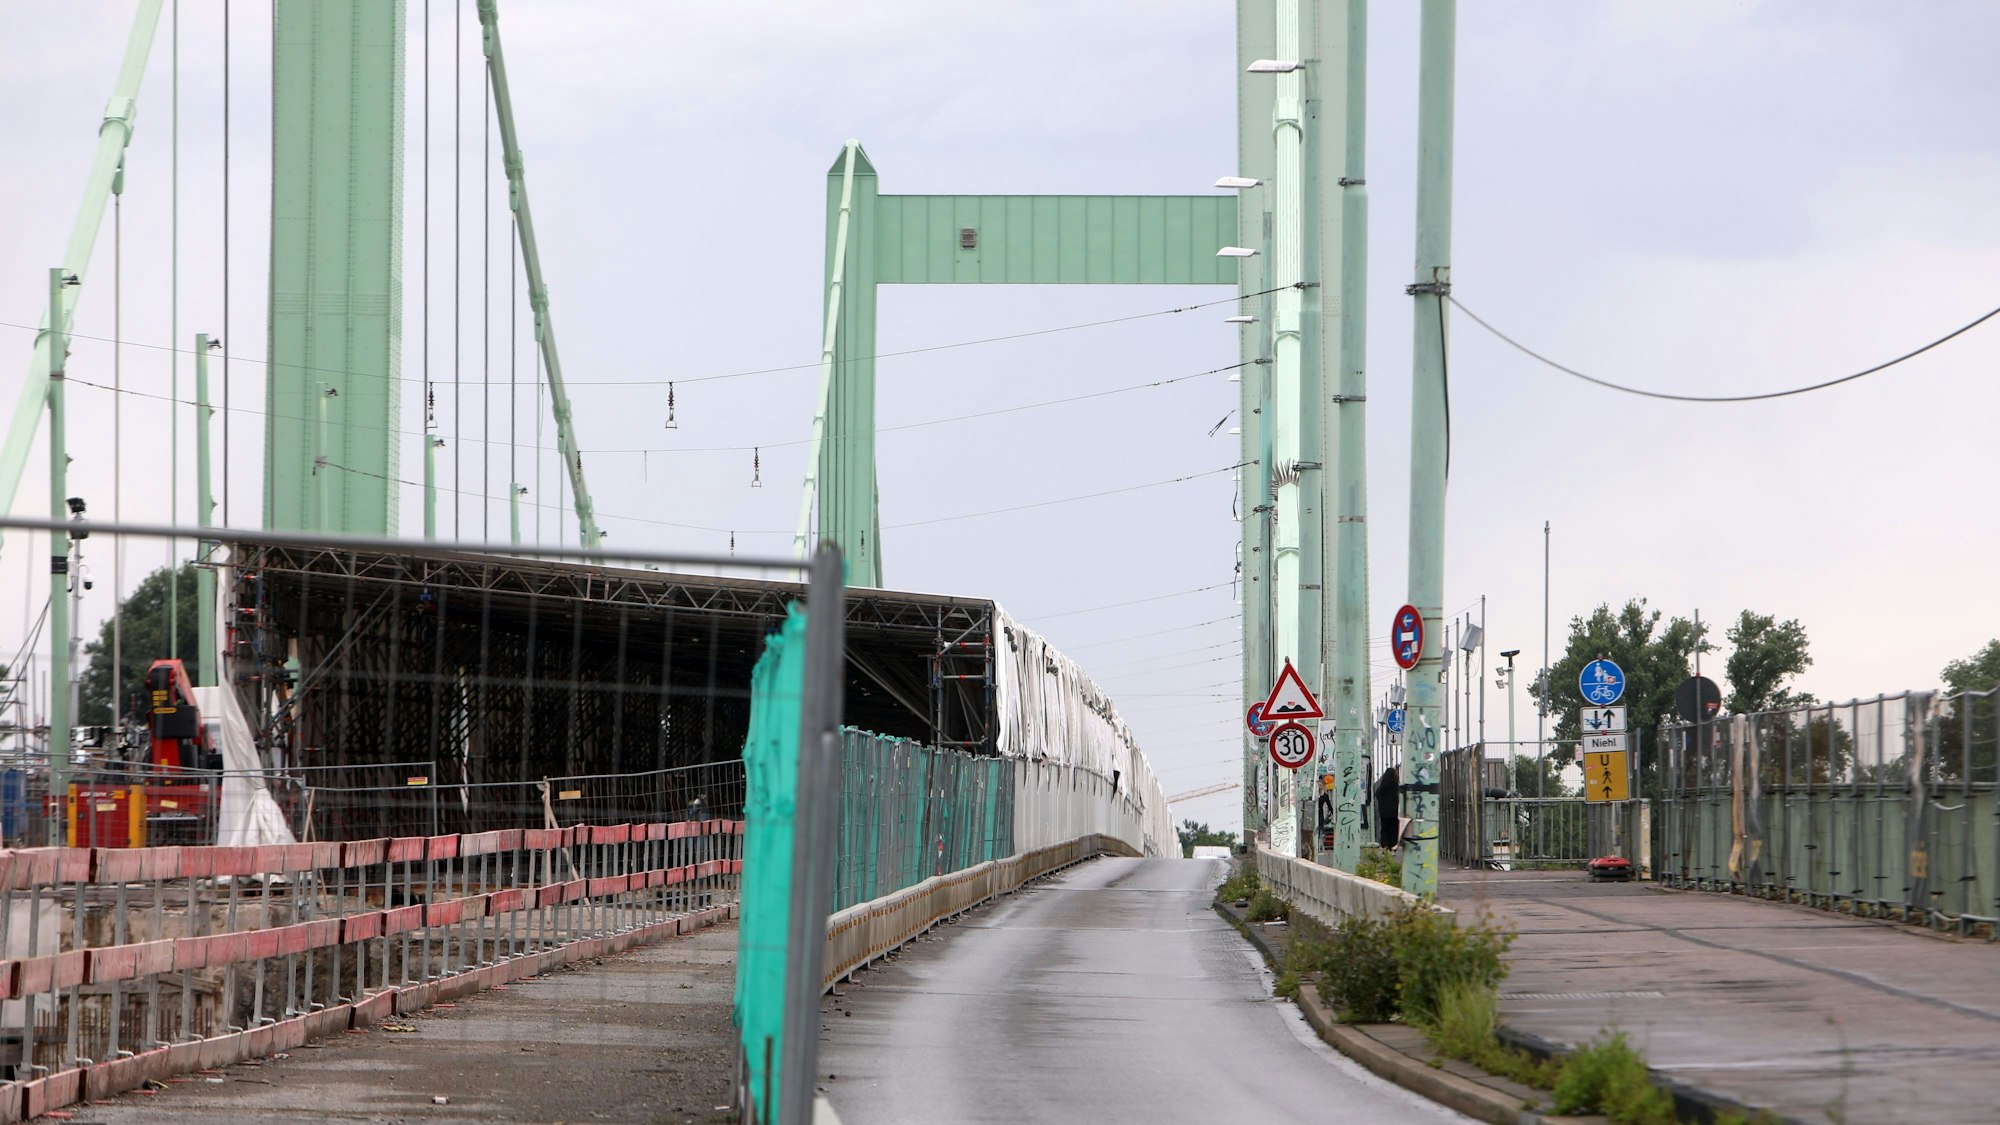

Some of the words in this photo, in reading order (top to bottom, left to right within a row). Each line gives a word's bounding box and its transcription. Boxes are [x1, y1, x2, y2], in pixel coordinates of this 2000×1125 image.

[1279, 735, 1305, 756] 30
[1592, 738, 1616, 747] Niehl
[1600, 754, 1610, 766] U
